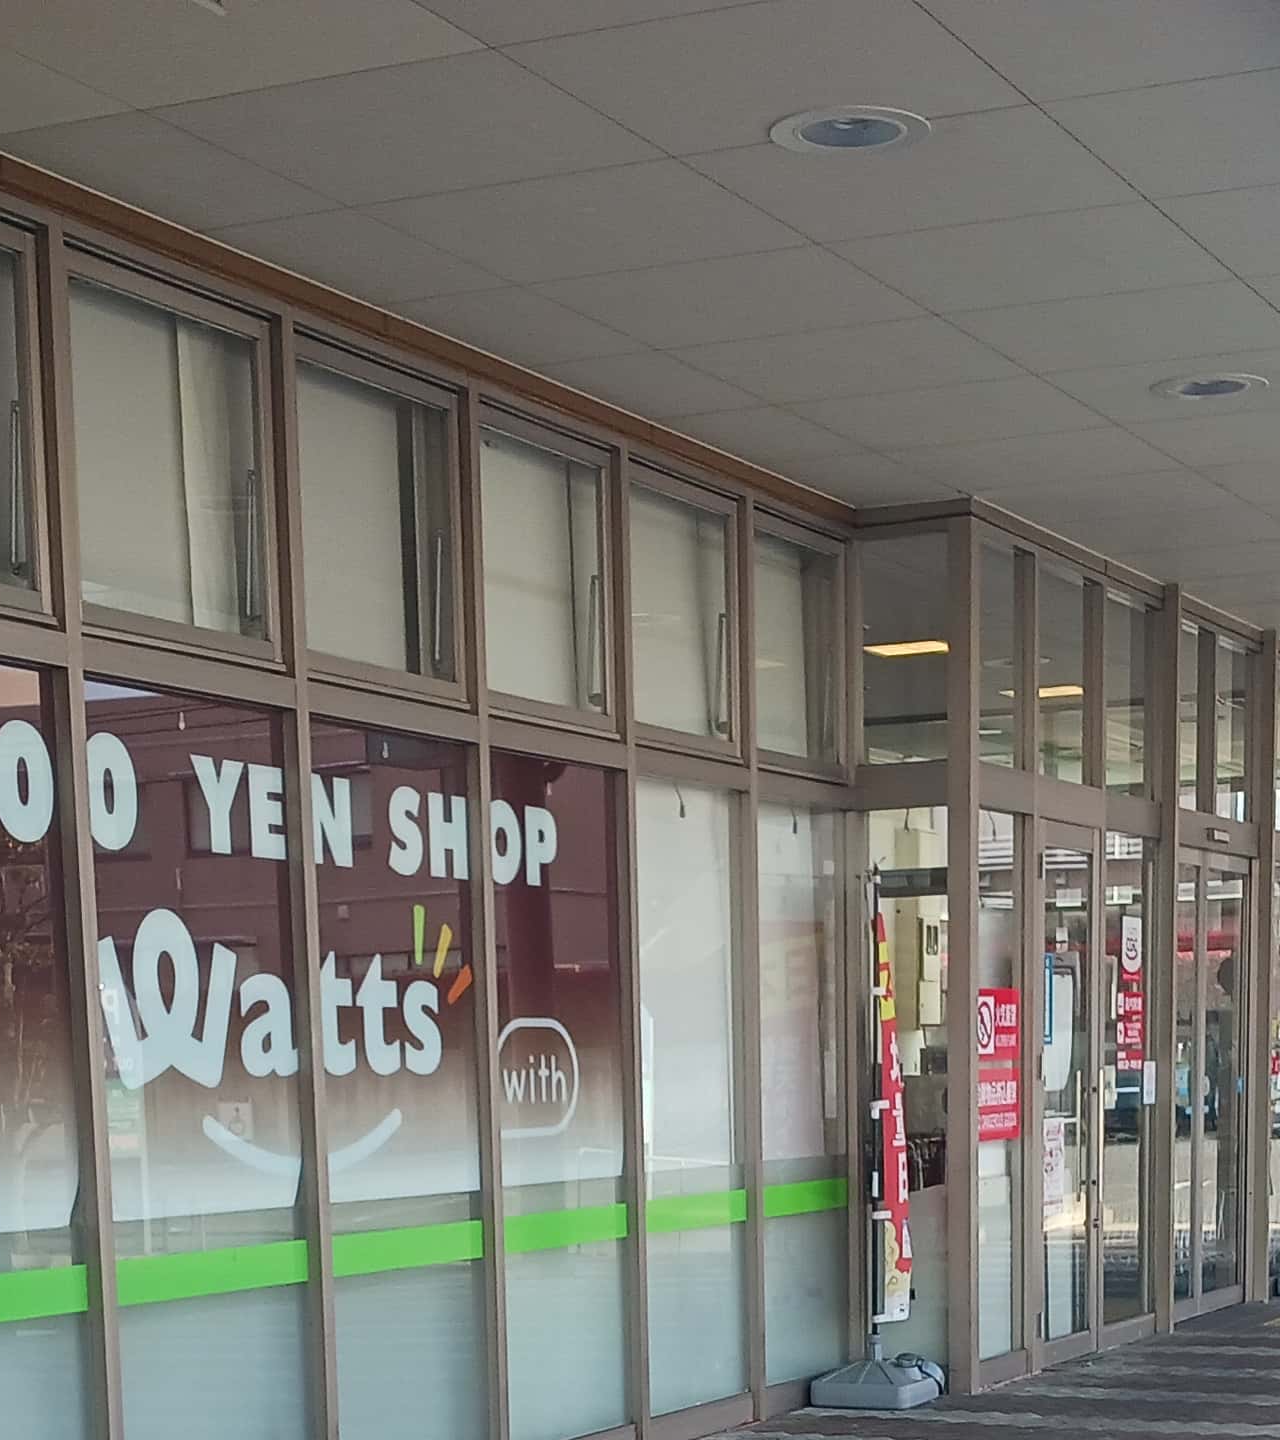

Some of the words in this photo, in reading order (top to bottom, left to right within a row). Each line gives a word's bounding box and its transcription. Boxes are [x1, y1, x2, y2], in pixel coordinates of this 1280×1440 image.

[190, 754, 354, 869] YEN
[389, 785, 558, 887] SHOP
[98, 908, 443, 1090] Watts
[503, 1054, 568, 1105] with
